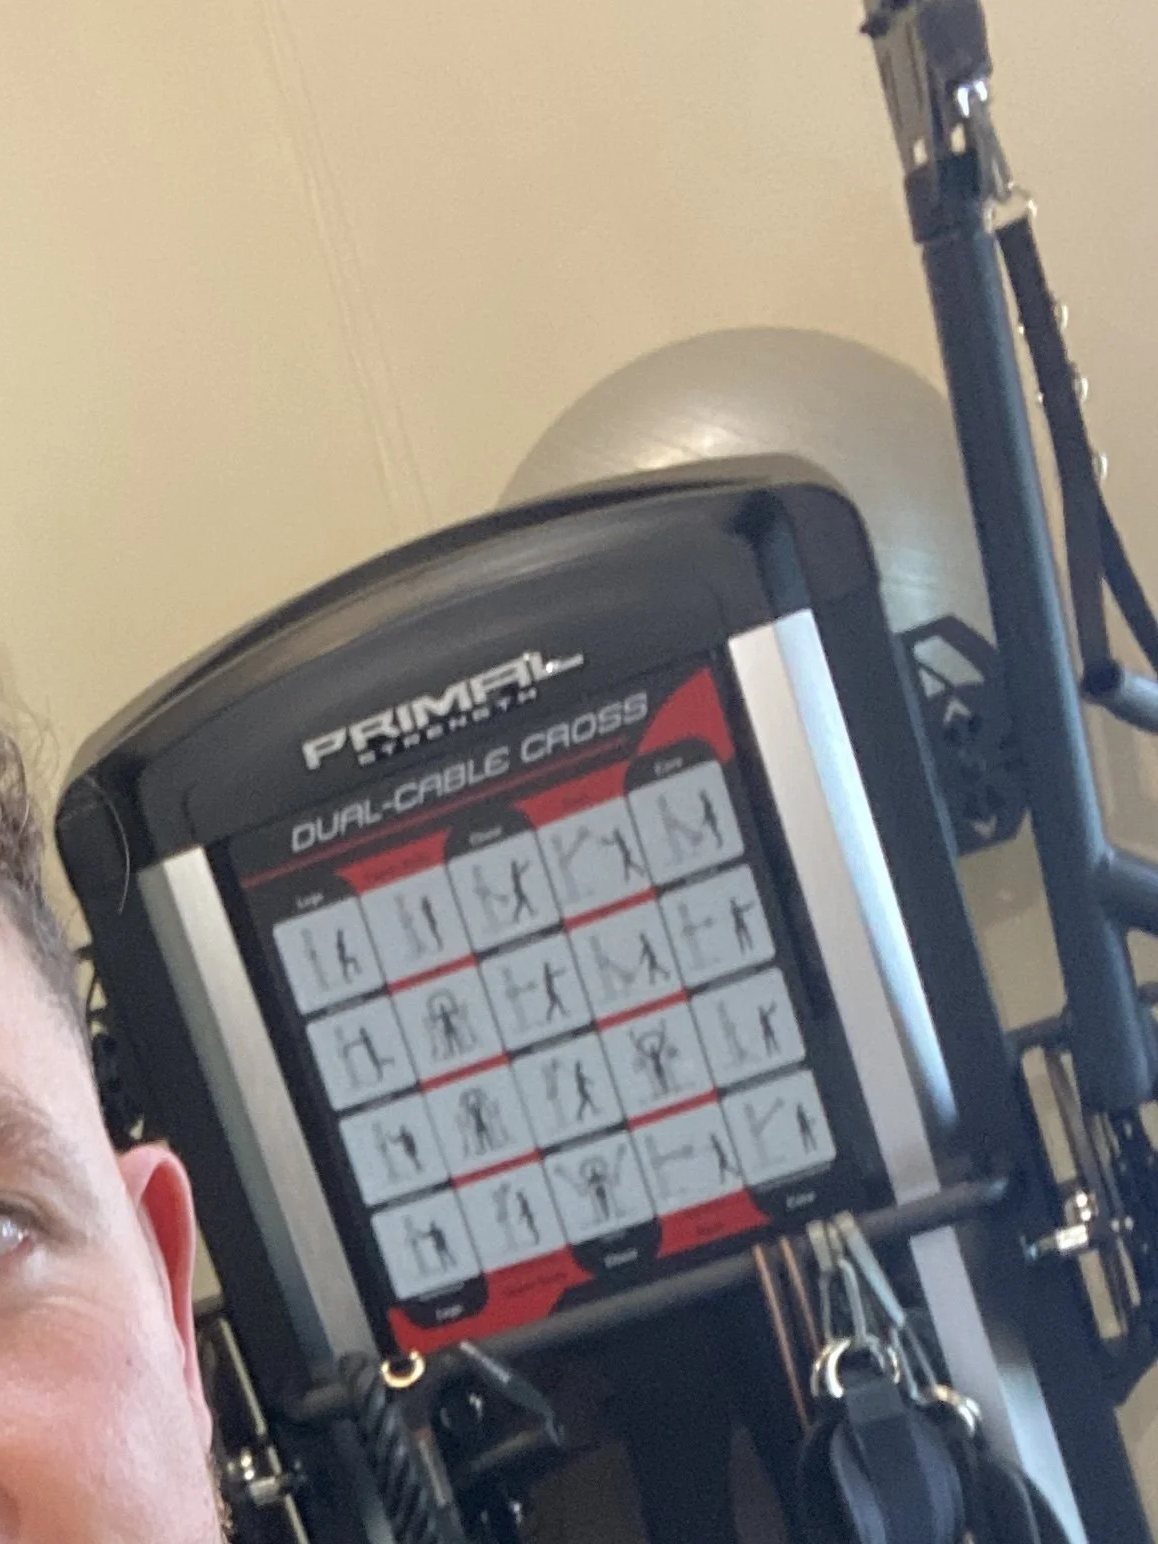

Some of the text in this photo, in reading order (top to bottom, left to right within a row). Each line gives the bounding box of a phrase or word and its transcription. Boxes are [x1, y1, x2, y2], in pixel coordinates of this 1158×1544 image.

[291, 692, 648, 853] DUAL-CABLE CROSS
[302, 651, 584, 770] PRIMAL
